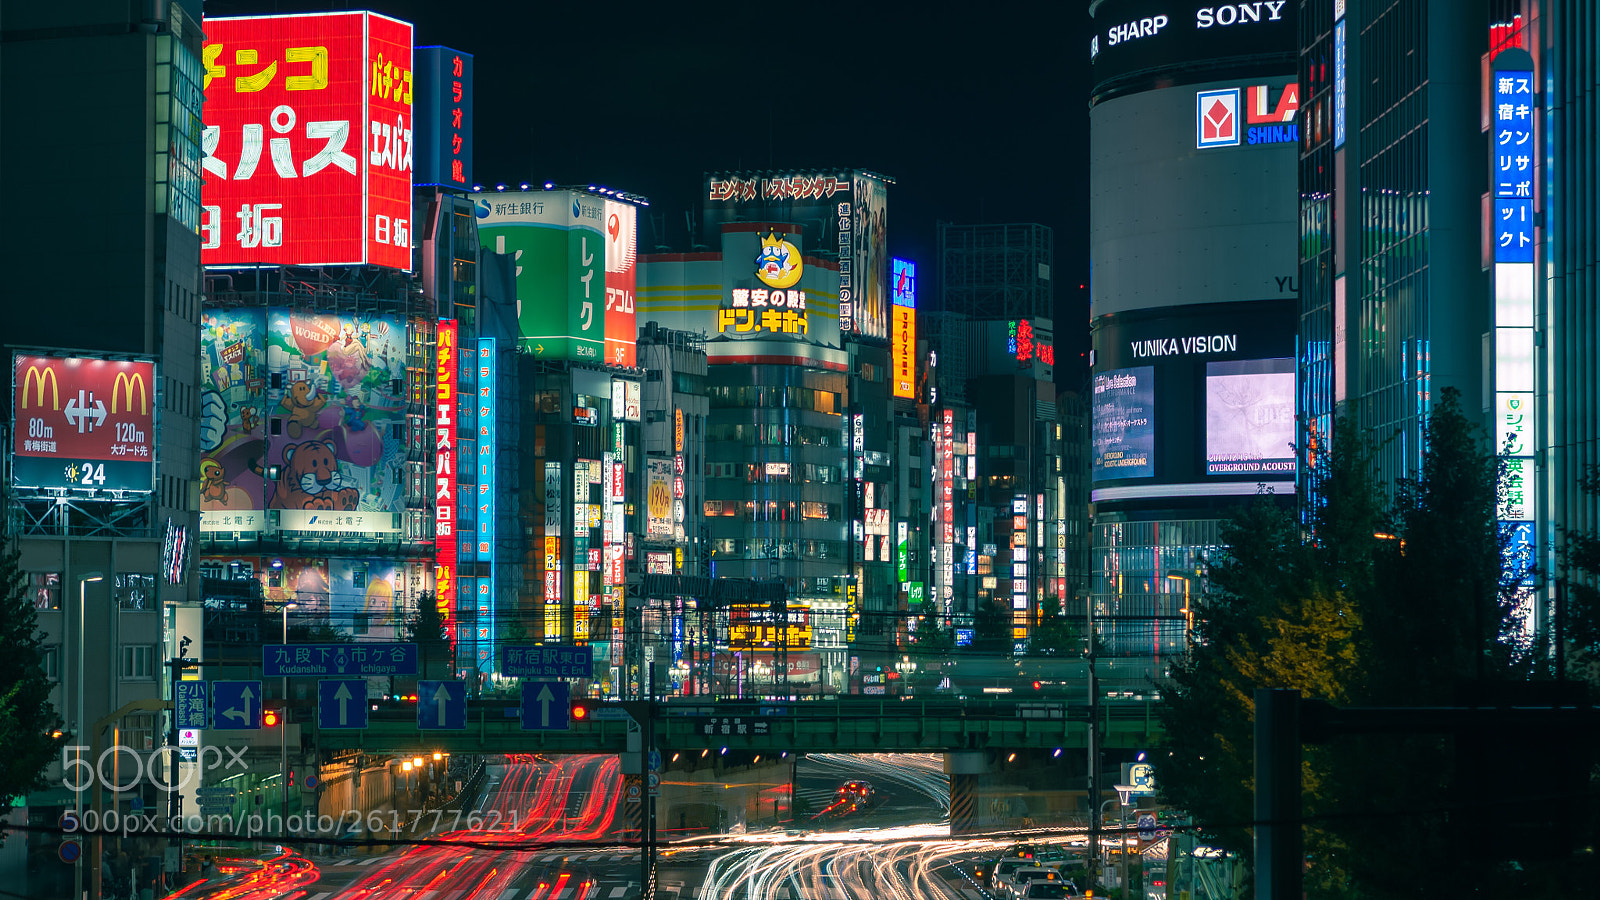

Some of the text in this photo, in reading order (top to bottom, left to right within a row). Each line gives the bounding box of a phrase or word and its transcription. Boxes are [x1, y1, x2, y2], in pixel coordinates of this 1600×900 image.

[1197, 1, 1286, 28] SONY
[1108, 15, 1168, 45] SHARP
[372, 53, 412, 105] パチンコ
[371, 113, 412, 172] エスパス
[1498, 77, 1514, 248] 新宿クリニック
[1515, 78, 1530, 248] スキンサポート
[710, 176, 850, 201] エンタメ レストランタワー
[495, 202, 544, 215] 新生銀行
[582, 205, 602, 221] 新生銀行
[581, 237, 593, 330] レイク
[606, 287, 634, 314] アコム
[295, 326, 330, 344] WORLD
[1131, 334, 1236, 358] YUNIKA VISION
[29, 417, 53, 438] 80m
[115, 422, 145, 442] 120m
[24, 440, 56, 453] 青梅街道
[111, 444, 147, 456] 大ガード先
[81, 463, 106, 485] 24
[1209, 463, 1260, 472] OVERGROUND
[223, 516, 254, 525] 北電子
[336, 517, 363, 525] 北電子
[911, 587, 922, 598] レイク
[275, 647, 331, 663] 九段下
[338, 656, 344, 664] 4
[507, 649, 587, 665] 新宿駅東口
[279, 665, 326, 673] Kudanshita
[361, 664, 396, 674] Ichigaya
[508, 666, 541, 676] Shinjuku
[179, 685, 188, 726] Otakibashi
[189, 683, 205, 727] 小滝橋
[704, 724, 747, 734] 新宿駅
